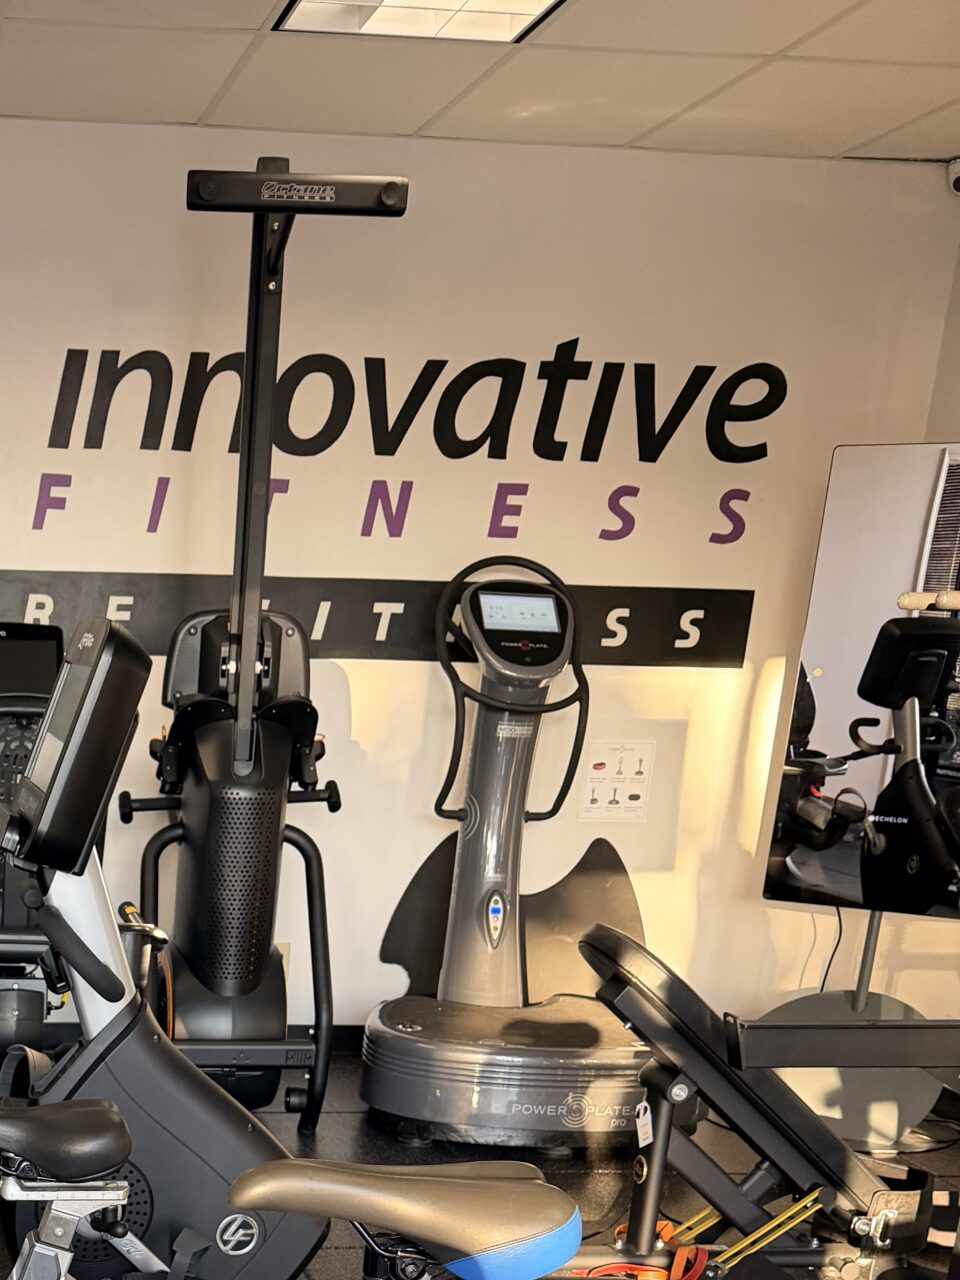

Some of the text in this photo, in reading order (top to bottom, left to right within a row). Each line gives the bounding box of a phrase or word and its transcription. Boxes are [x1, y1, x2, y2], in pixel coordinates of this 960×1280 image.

[47, 336, 788, 464] innovative
[874, 815, 908, 824] ECHELON
[511, 1103, 632, 1117] POWER PLATE
[610, 1118, 627, 1129] pro
